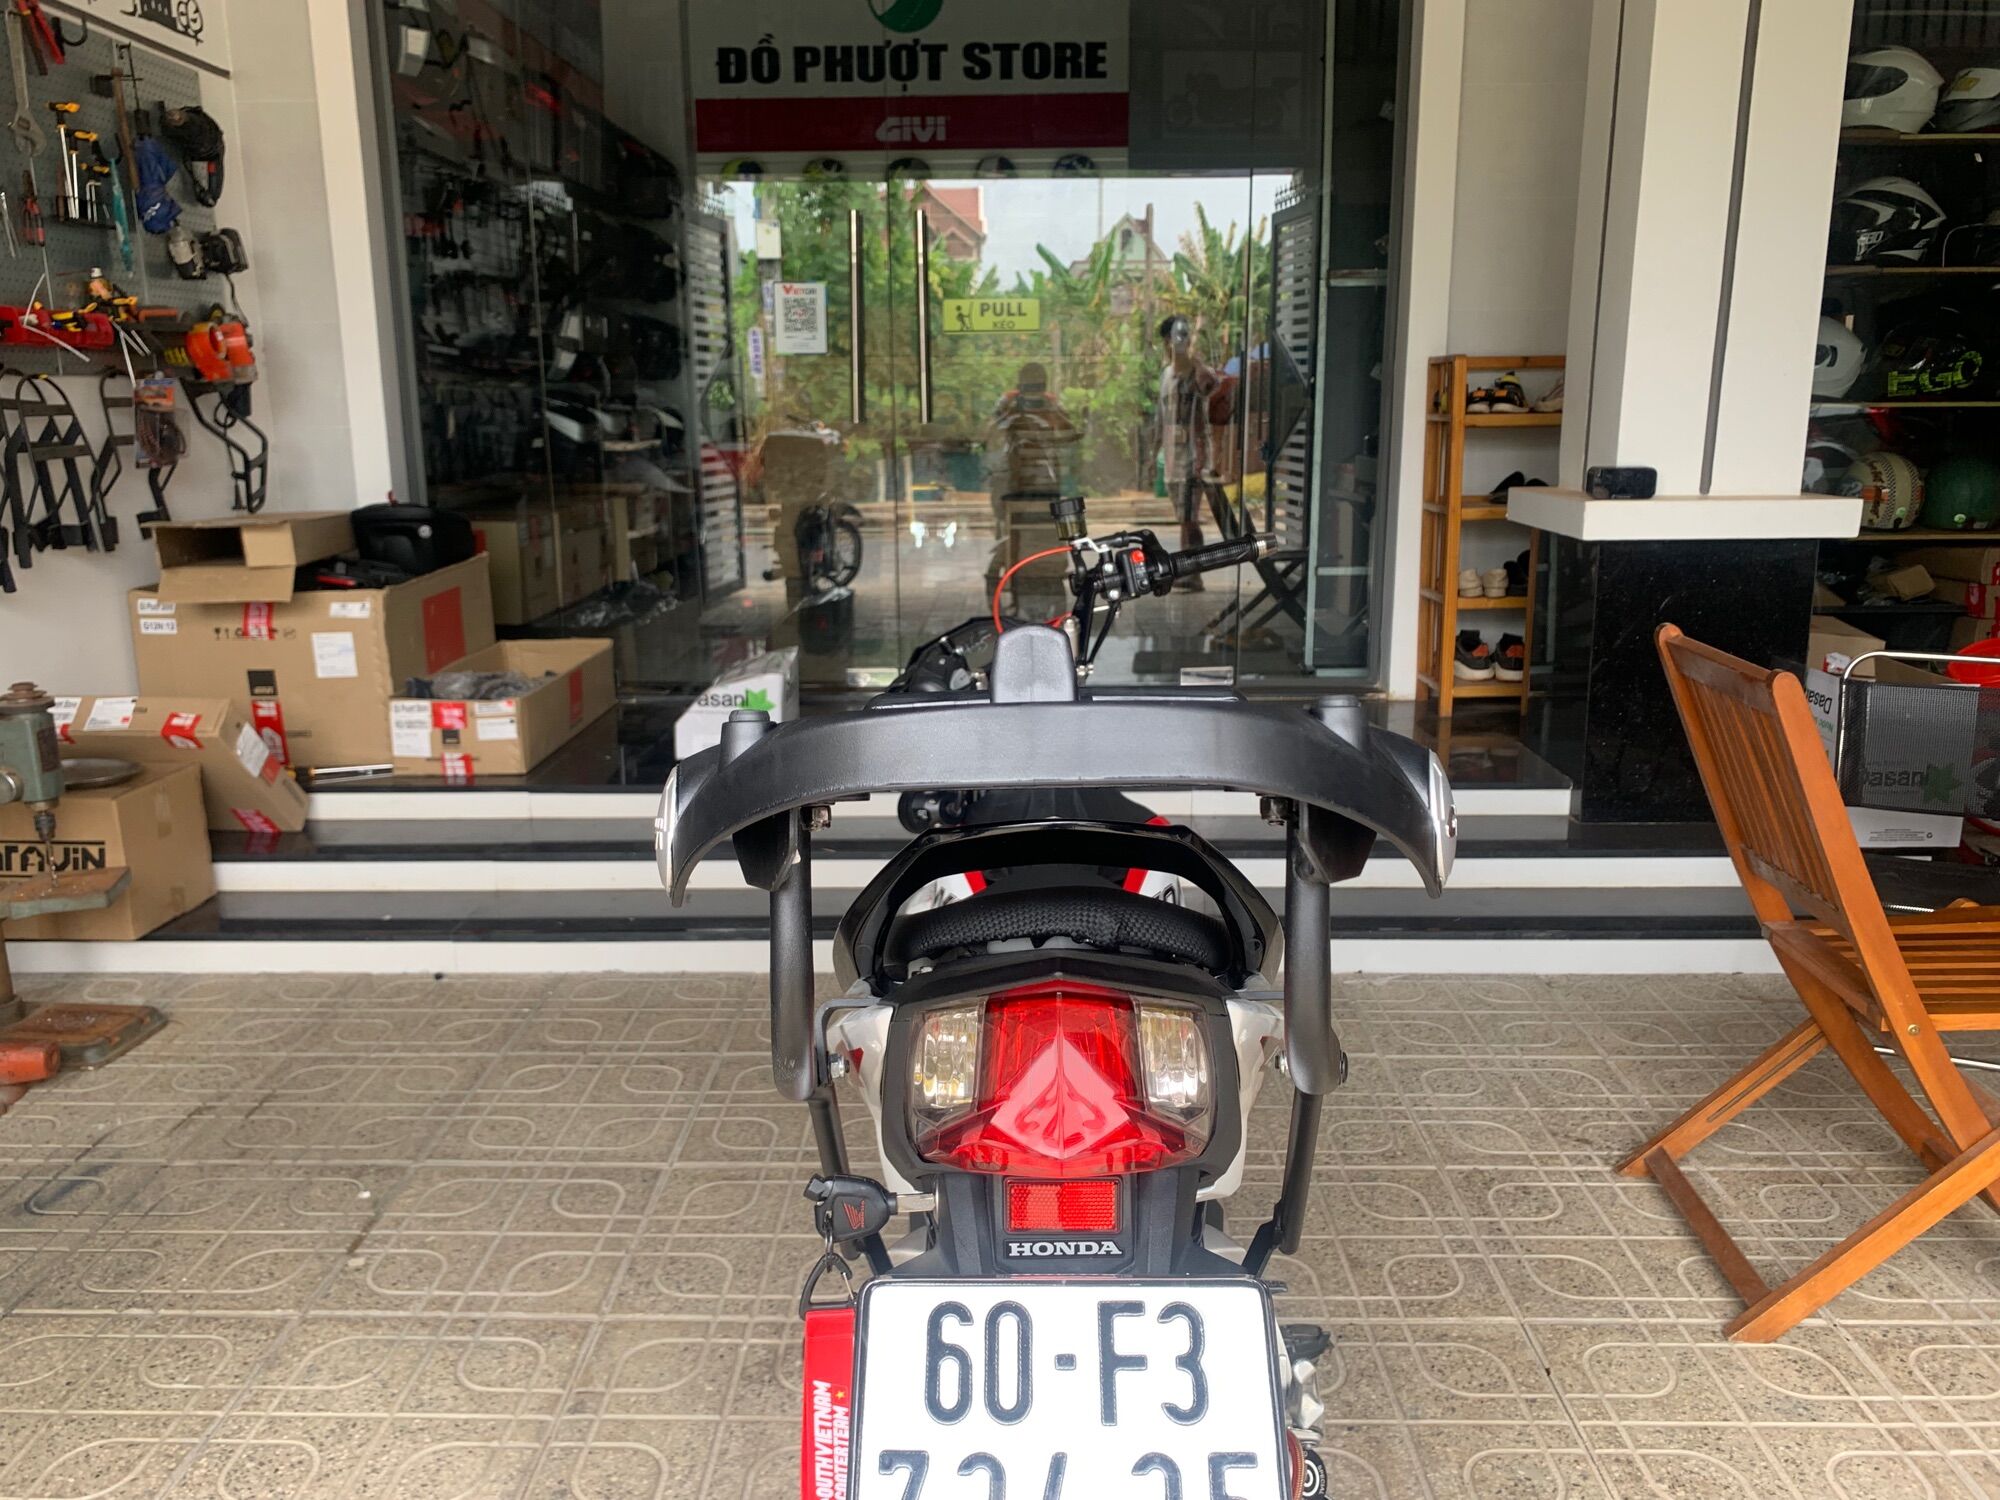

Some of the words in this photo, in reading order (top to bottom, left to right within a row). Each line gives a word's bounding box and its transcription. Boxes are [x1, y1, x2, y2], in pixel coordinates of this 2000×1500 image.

[716, 33, 780, 84] ĐỒ
[793, 38, 948, 92] PHƯỢT
[963, 42, 1107, 80] STORE
[875, 116, 946, 142] GIVI
[980, 302, 1027, 317] PULL
[697, 688, 749, 707] asani
[1008, 1241, 1122, 1256] HONDA
[924, 1300, 1208, 1426] 60-F3
[812, 1379, 833, 1500] OUTHVIETNAM
[831, 1404, 849, 1500] COOTERTEAM
[1317, 1464, 1326, 1495] SPECIAL
